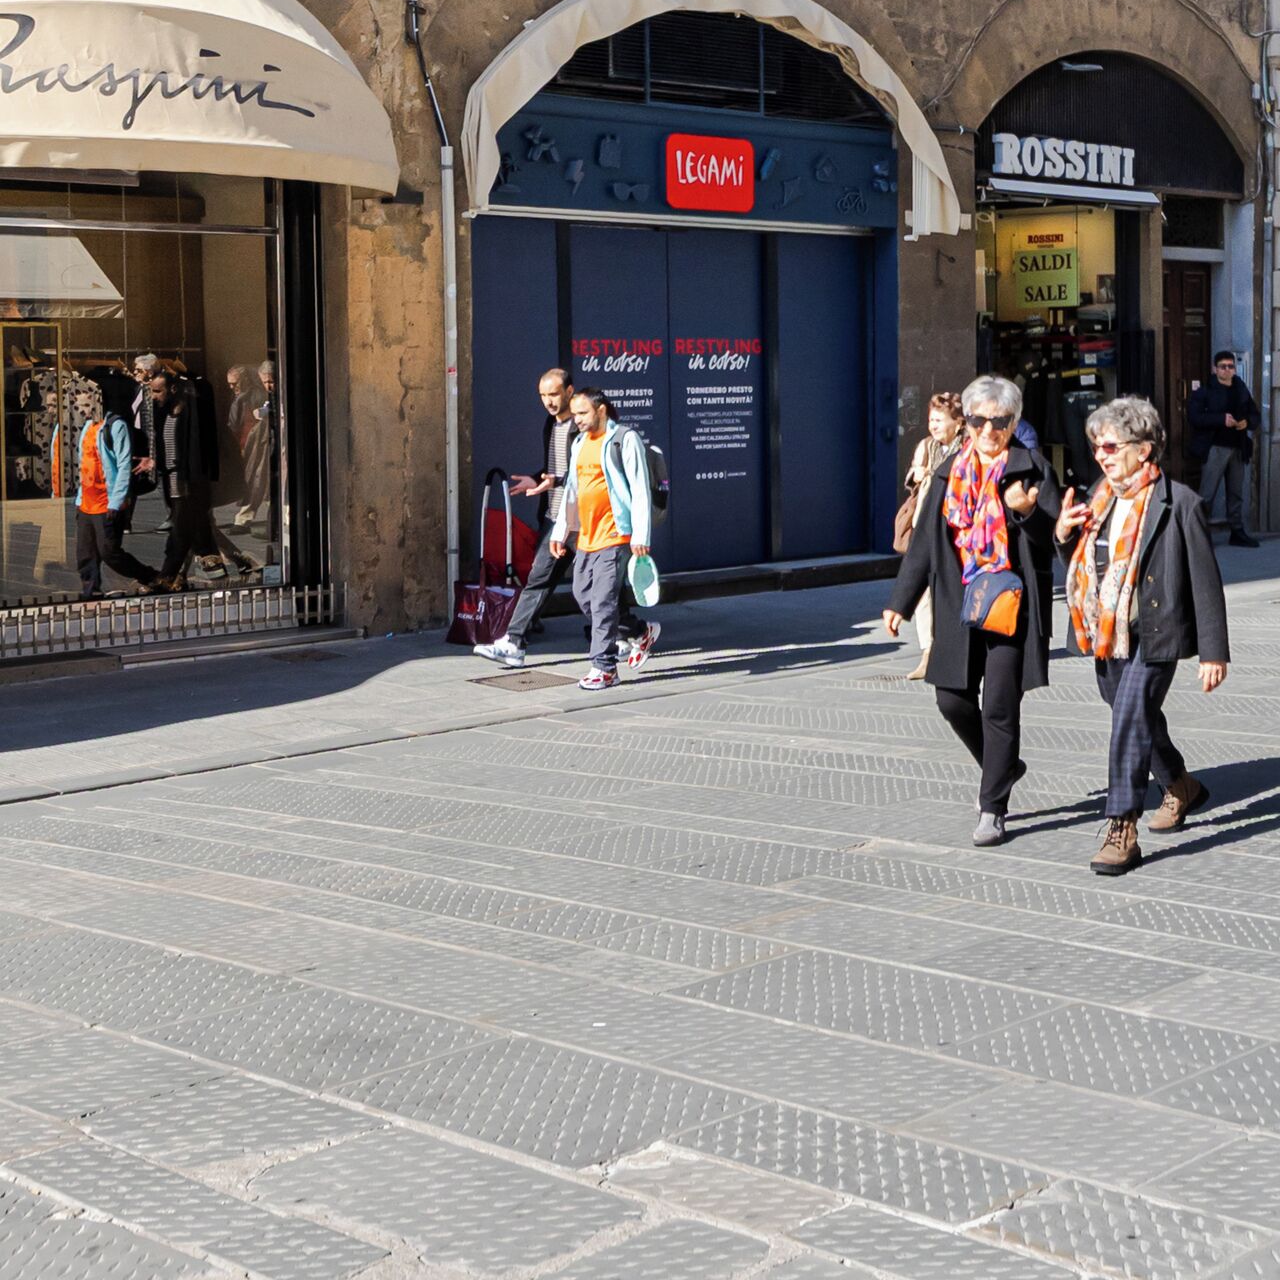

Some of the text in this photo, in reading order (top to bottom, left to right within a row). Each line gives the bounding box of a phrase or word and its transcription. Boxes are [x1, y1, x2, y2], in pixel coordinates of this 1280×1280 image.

[992, 133, 1135, 186] ROSSINI
[1028, 234, 1064, 244] ROSSINI
[1020, 253, 1072, 273] SALDI
[1025, 284, 1068, 302] SALE
[675, 337, 762, 355] RESTYLING
[582, 351, 650, 374] in corso!
[688, 349, 750, 372] in corso!
[625, 389, 653, 397] PRESTO
[728, 385, 753, 394] PRESTO
